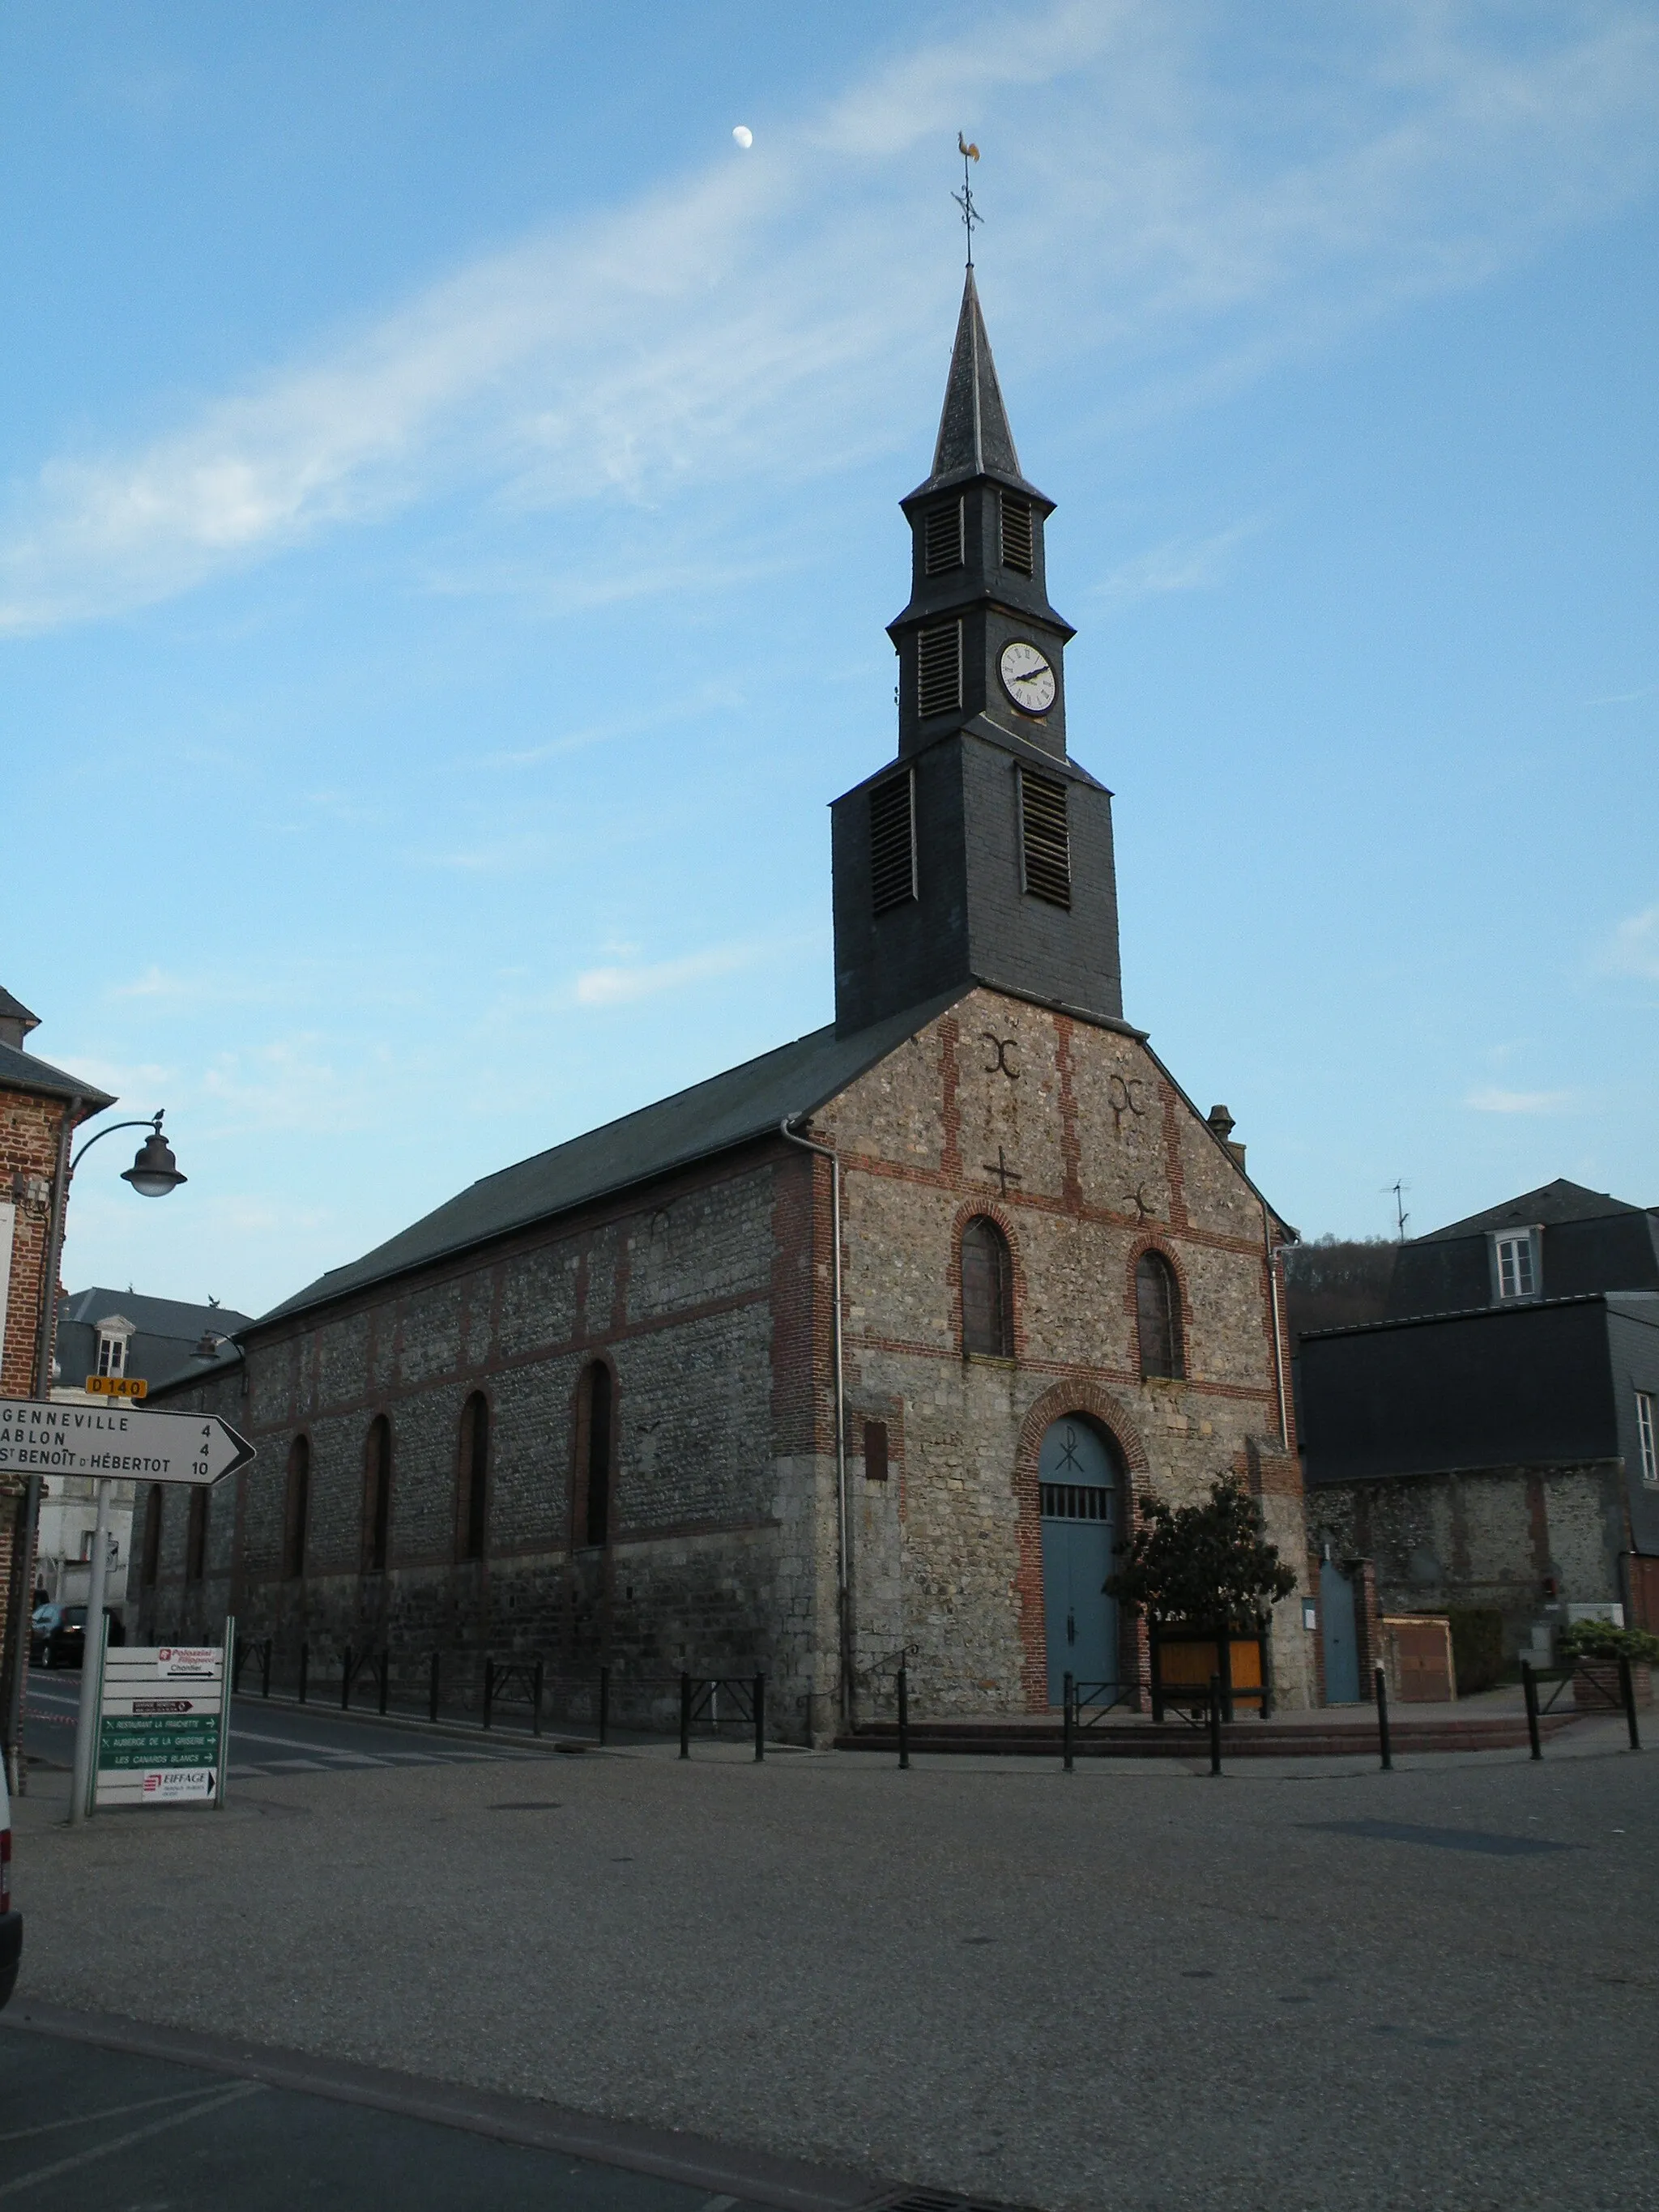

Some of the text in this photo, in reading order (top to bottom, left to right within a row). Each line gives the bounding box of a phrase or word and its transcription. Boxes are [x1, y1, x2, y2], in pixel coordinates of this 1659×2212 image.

[92, 1379, 141, 1395] D 140
[2, 1409, 211, 1438] GENNEVILLE 4
[0, 1428, 209, 1456] ABLON 4
[19, 1449, 76, 1466] BENOÎT
[192, 1462, 209, 1476] 10
[116, 1720, 152, 1729] RESTAURANT
[155, 1720, 163, 1728] LA
[113, 1737, 146, 1746] AUBERGE
[149, 1737, 159, 1745] DE
[162, 1737, 171, 1745] LA
[114, 1754, 200, 1764] LES CANARDS BLANCS
[164, 1773, 205, 1784] EIFFAGE
